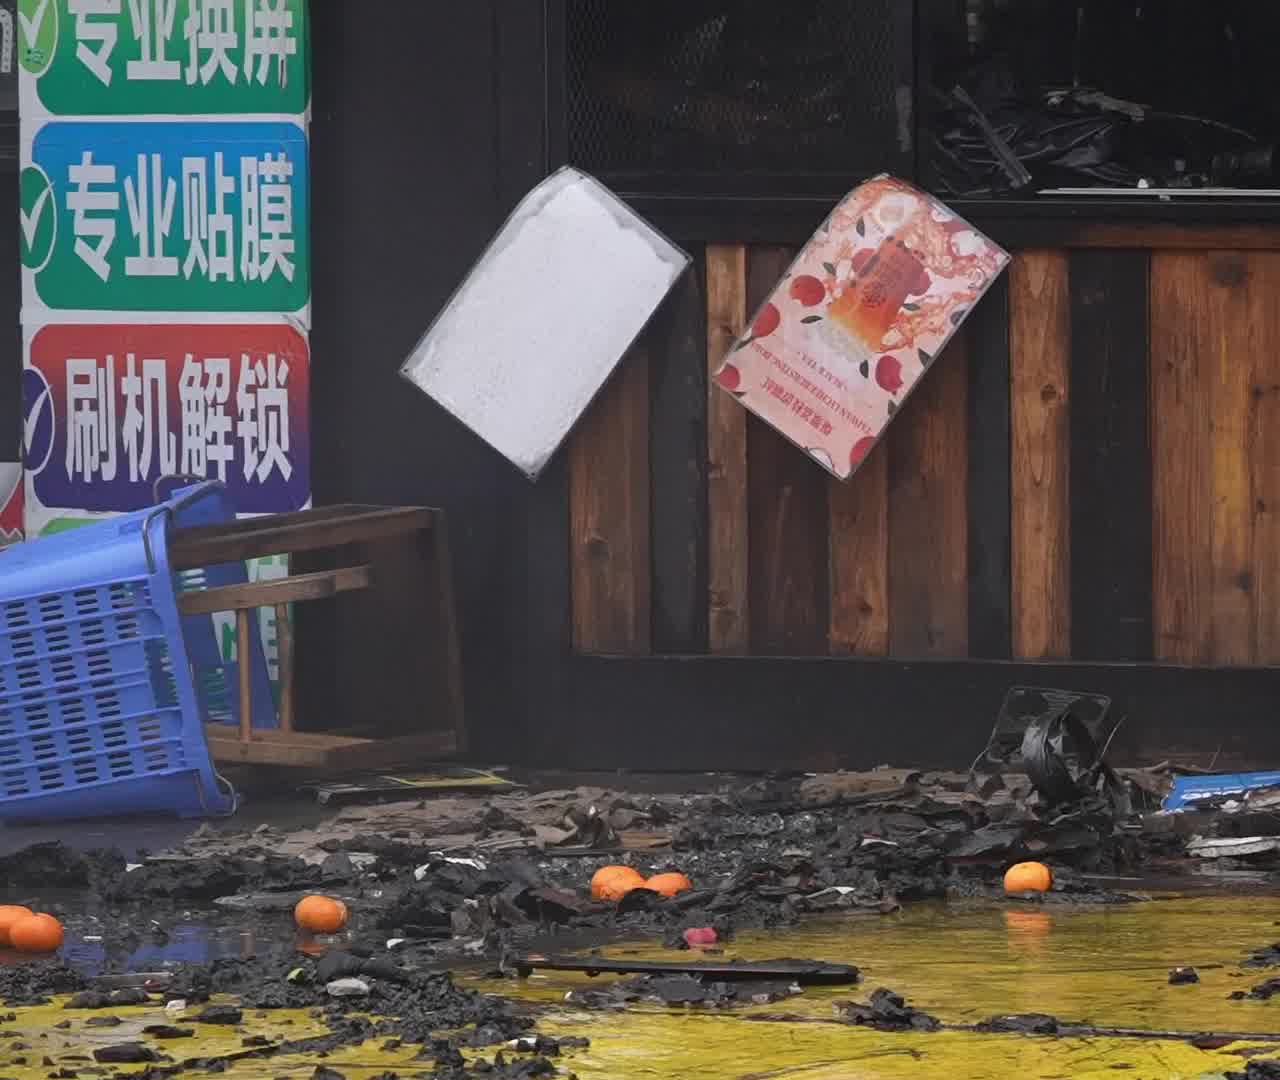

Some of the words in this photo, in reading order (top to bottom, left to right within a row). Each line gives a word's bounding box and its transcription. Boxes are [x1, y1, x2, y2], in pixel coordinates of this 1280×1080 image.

[68, 0, 297, 87] 专业换屏
[67, 152, 295, 282] 专业贴膜
[65, 354, 293, 484] 刷机解锁
